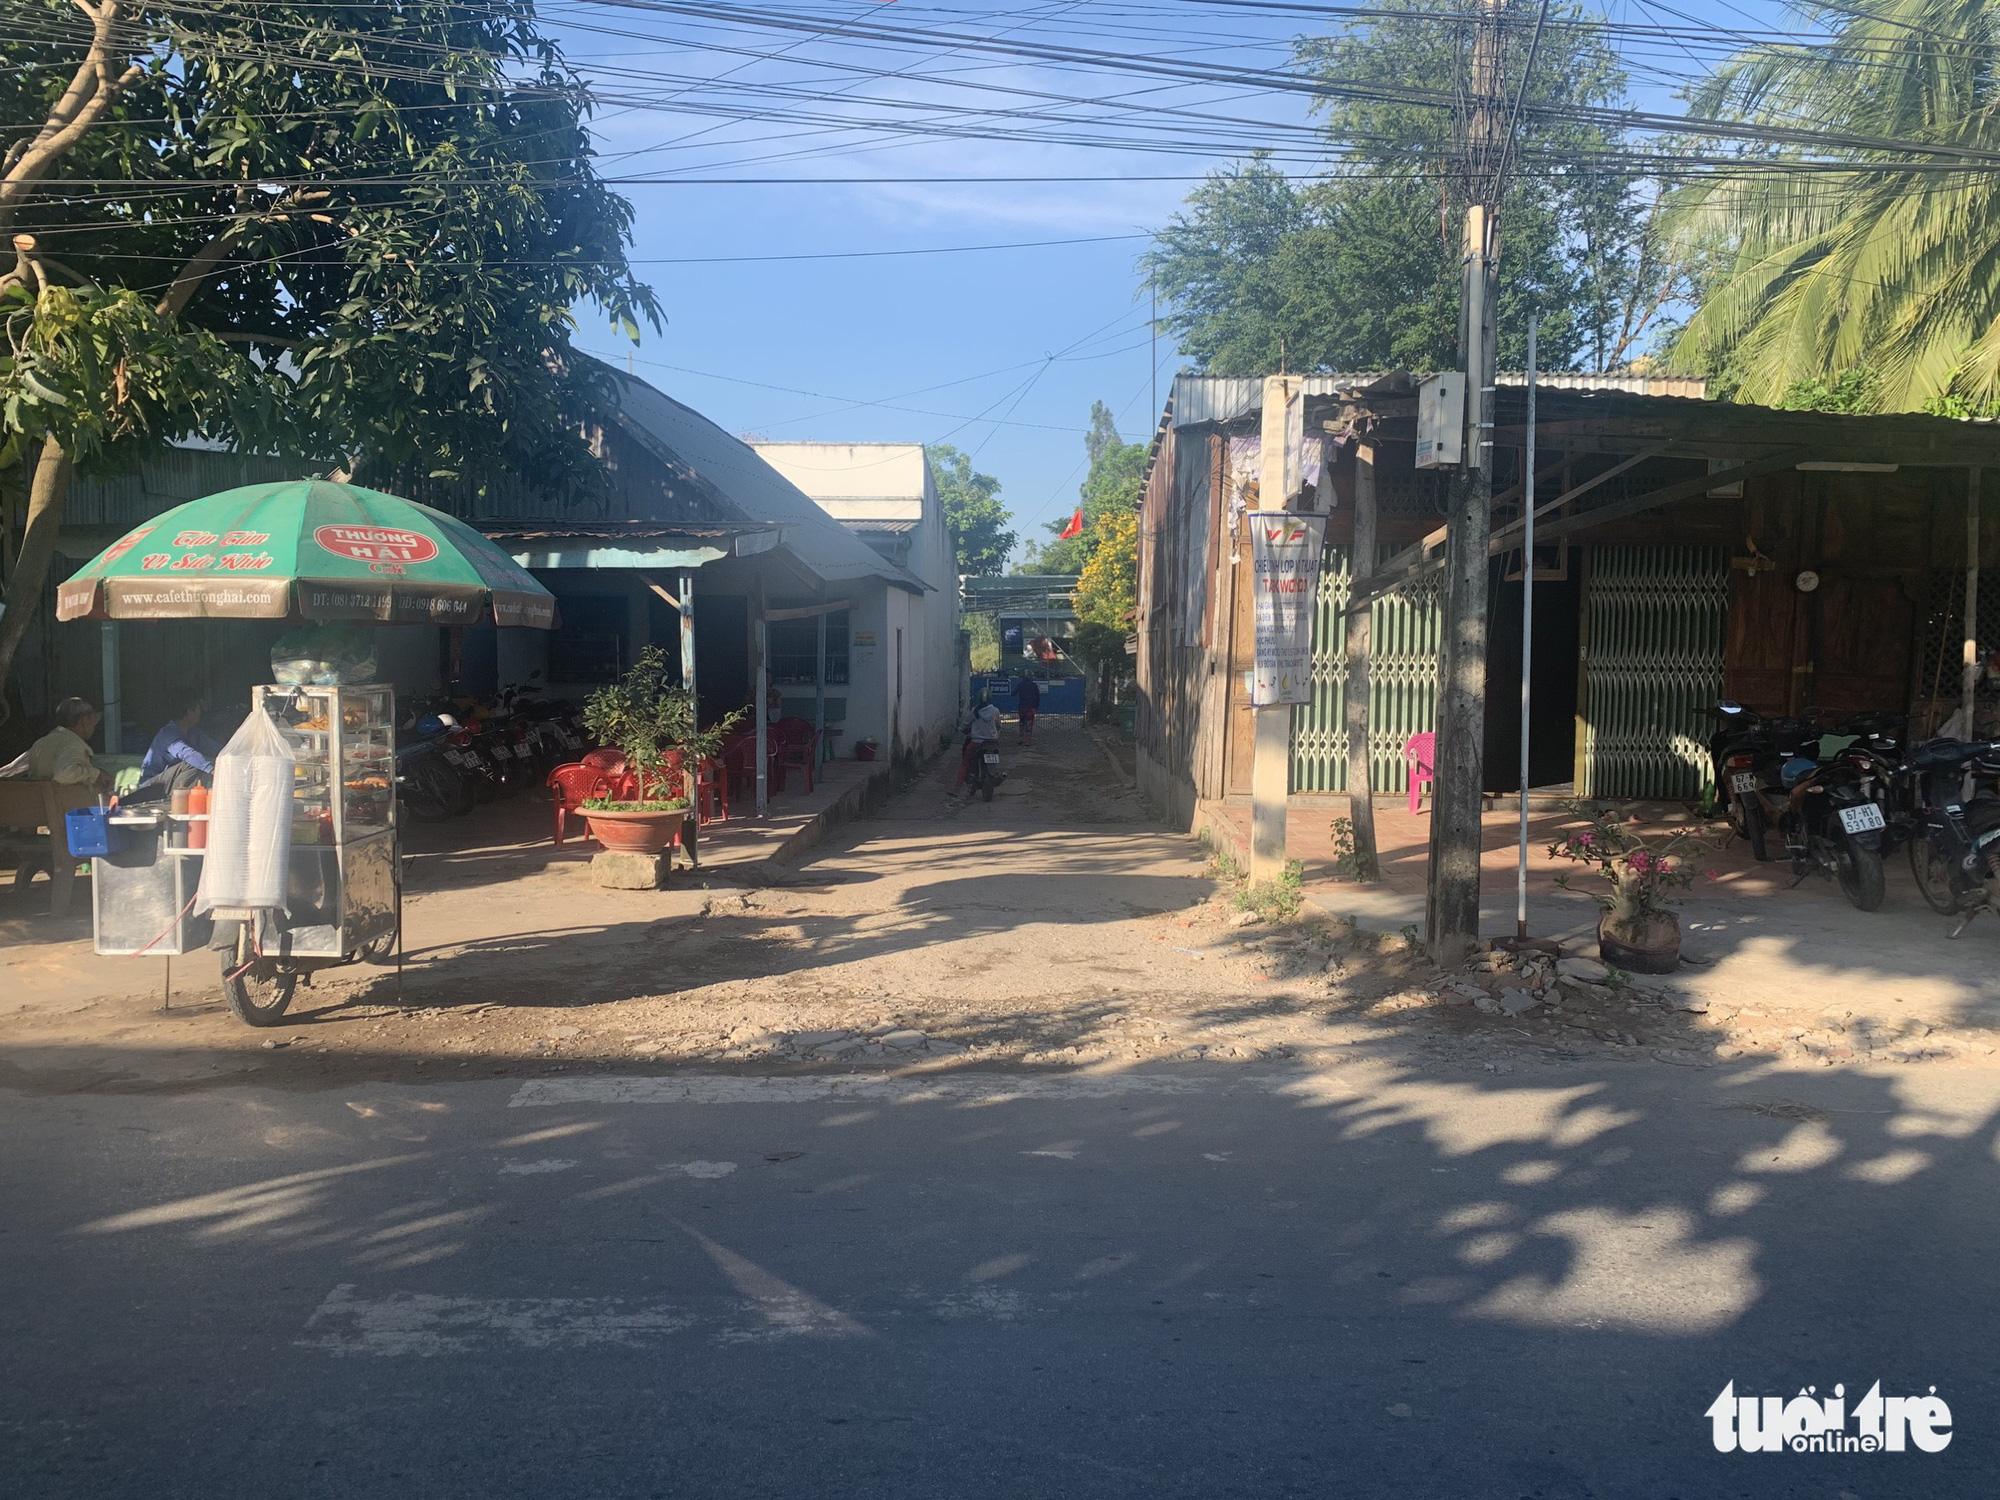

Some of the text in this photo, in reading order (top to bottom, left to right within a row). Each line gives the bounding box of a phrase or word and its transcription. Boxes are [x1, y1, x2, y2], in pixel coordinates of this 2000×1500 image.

[122, 589, 272, 606] www.cafethuonghai.com
[330, 592, 349, 607] (08)
[350, 593, 370, 608] 3712
[371, 595, 392, 609] 1199
[436, 598, 452, 613] 606
[452, 599, 468, 613] 644
[1845, 806, 1874, 820] 67-H1
[1846, 815, 1883, 832] 531.80
